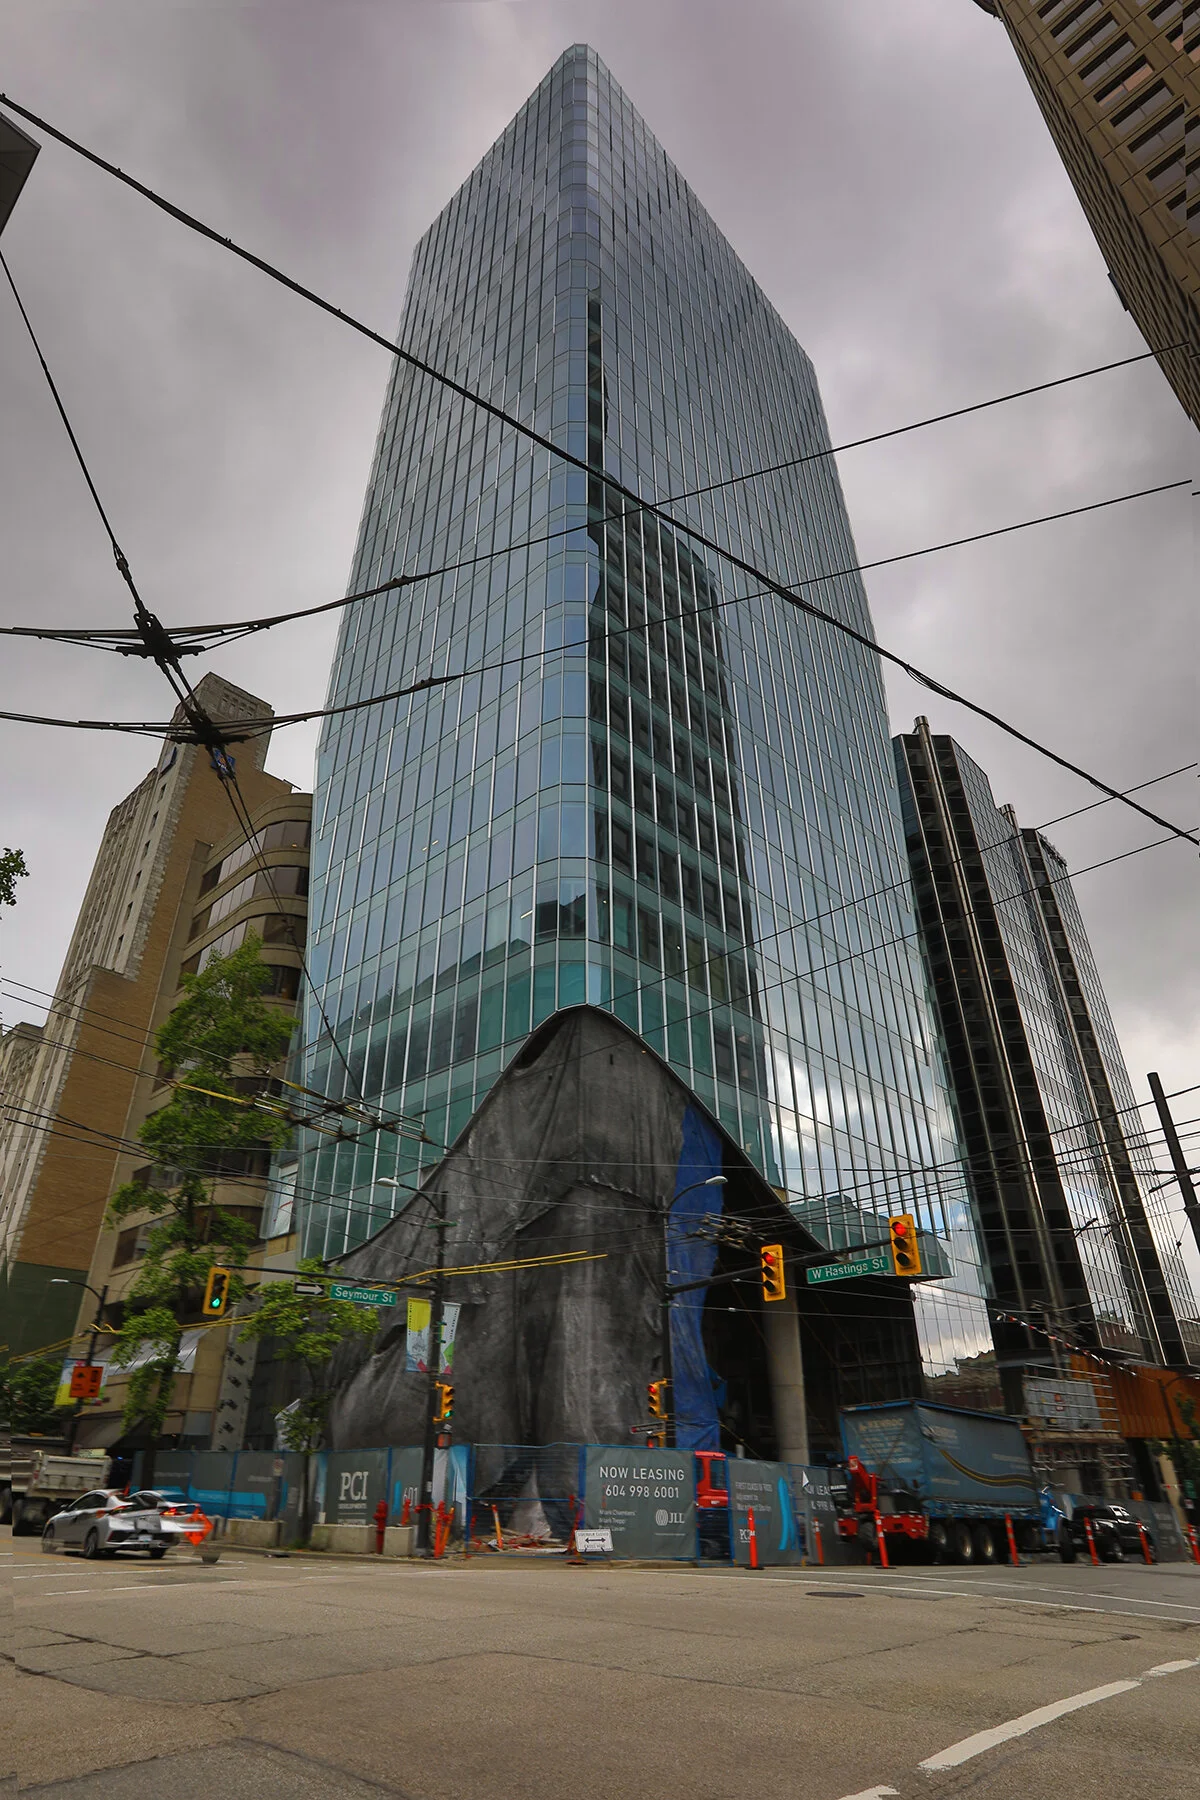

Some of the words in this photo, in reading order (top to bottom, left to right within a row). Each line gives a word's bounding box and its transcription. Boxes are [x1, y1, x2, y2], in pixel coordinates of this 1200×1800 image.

[812, 1269, 822, 1279] W
[825, 1261, 868, 1277] Hastings
[872, 1258, 884, 1270] St
[335, 1286, 379, 1301] Seymour
[381, 1292, 393, 1303] St
[600, 1466, 628, 1479] NOW
[633, 1468, 685, 1480] LEASING
[339, 1471, 369, 1501] PCI
[605, 1484, 626, 1497] 604
[629, 1485, 650, 1498] 998
[654, 1486, 679, 1498] 6001
[669, 1512, 685, 1524] JLL
